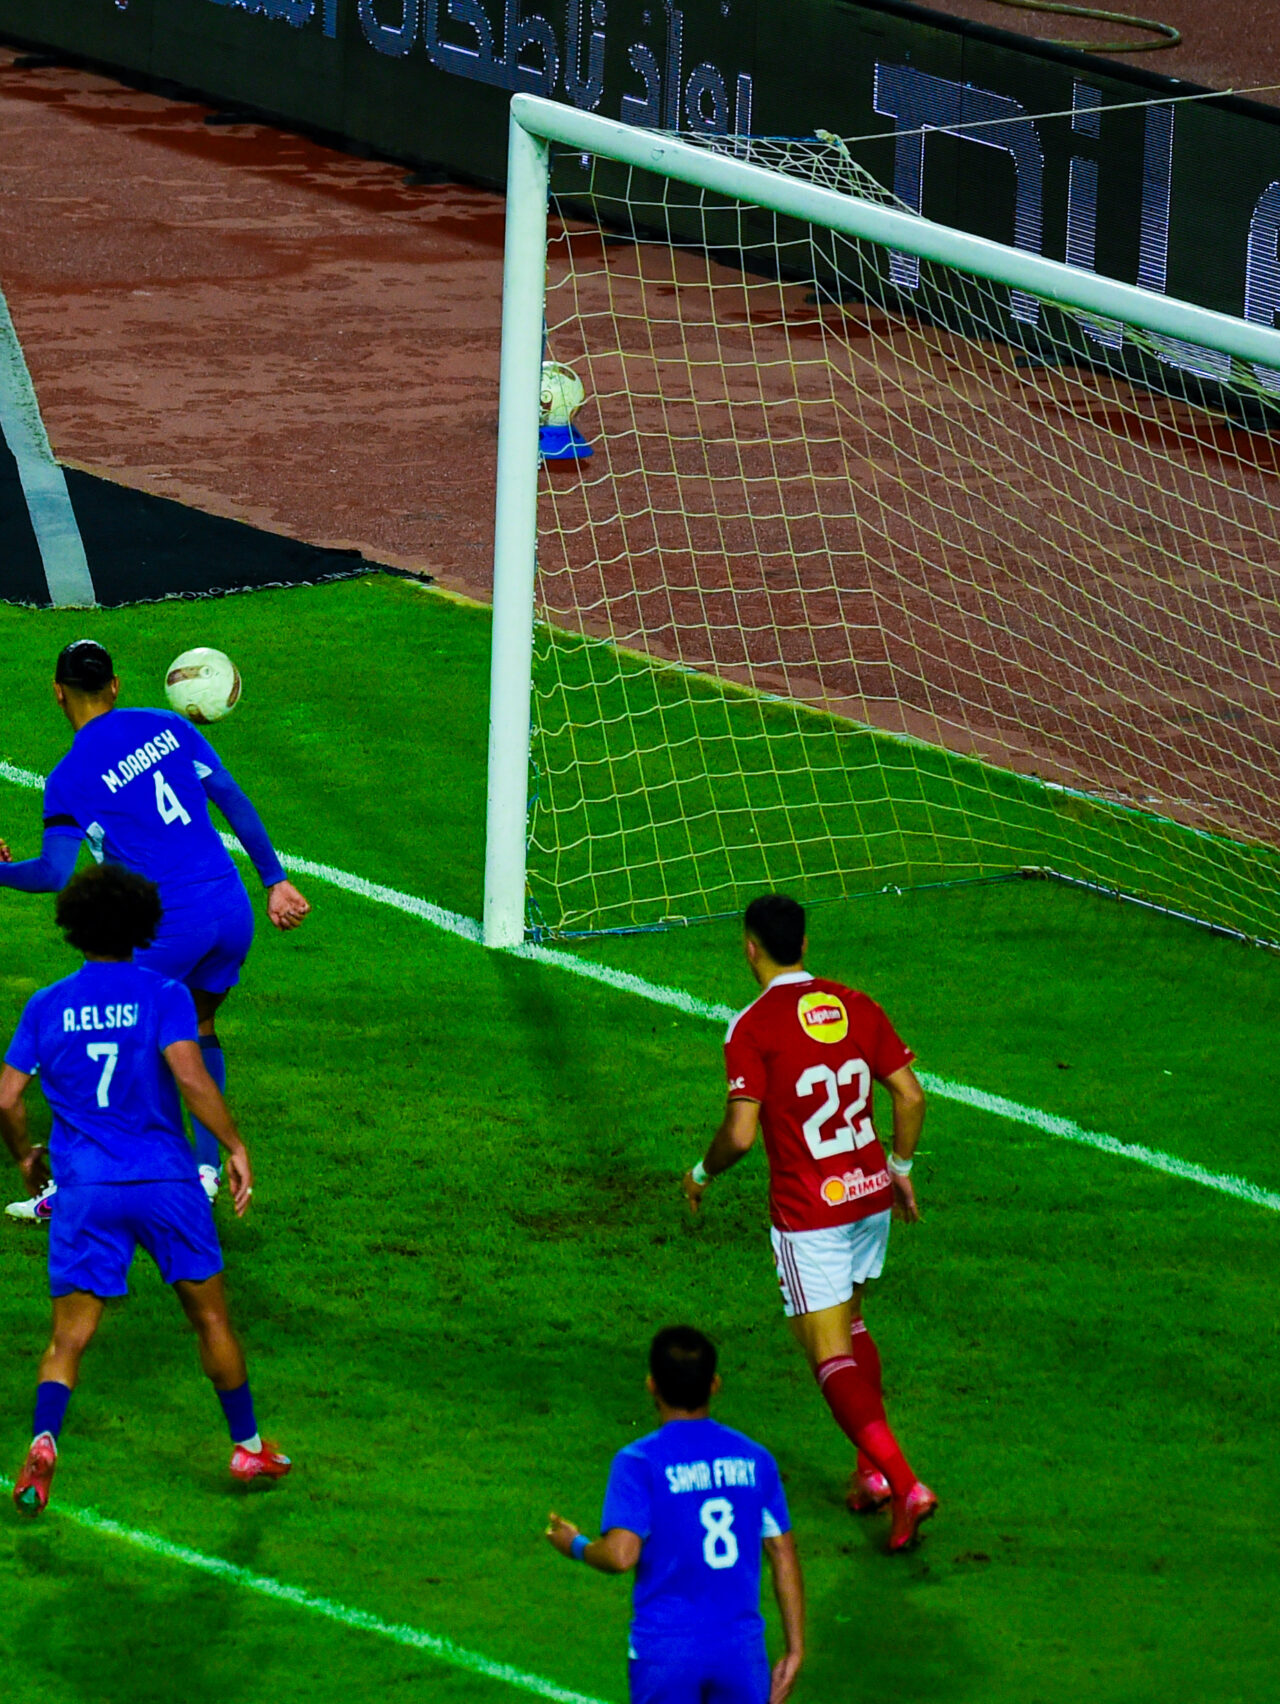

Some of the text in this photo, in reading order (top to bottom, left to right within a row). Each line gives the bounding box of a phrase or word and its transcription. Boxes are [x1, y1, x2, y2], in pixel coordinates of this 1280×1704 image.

[101, 729, 180, 793] M.DABASH
[153, 770, 192, 825] 4
[806, 1008, 841, 1024] Lipton
[87, 1042, 118, 1107] 7
[796, 1058, 876, 1160] 22
[699, 1496, 739, 1570] 8
